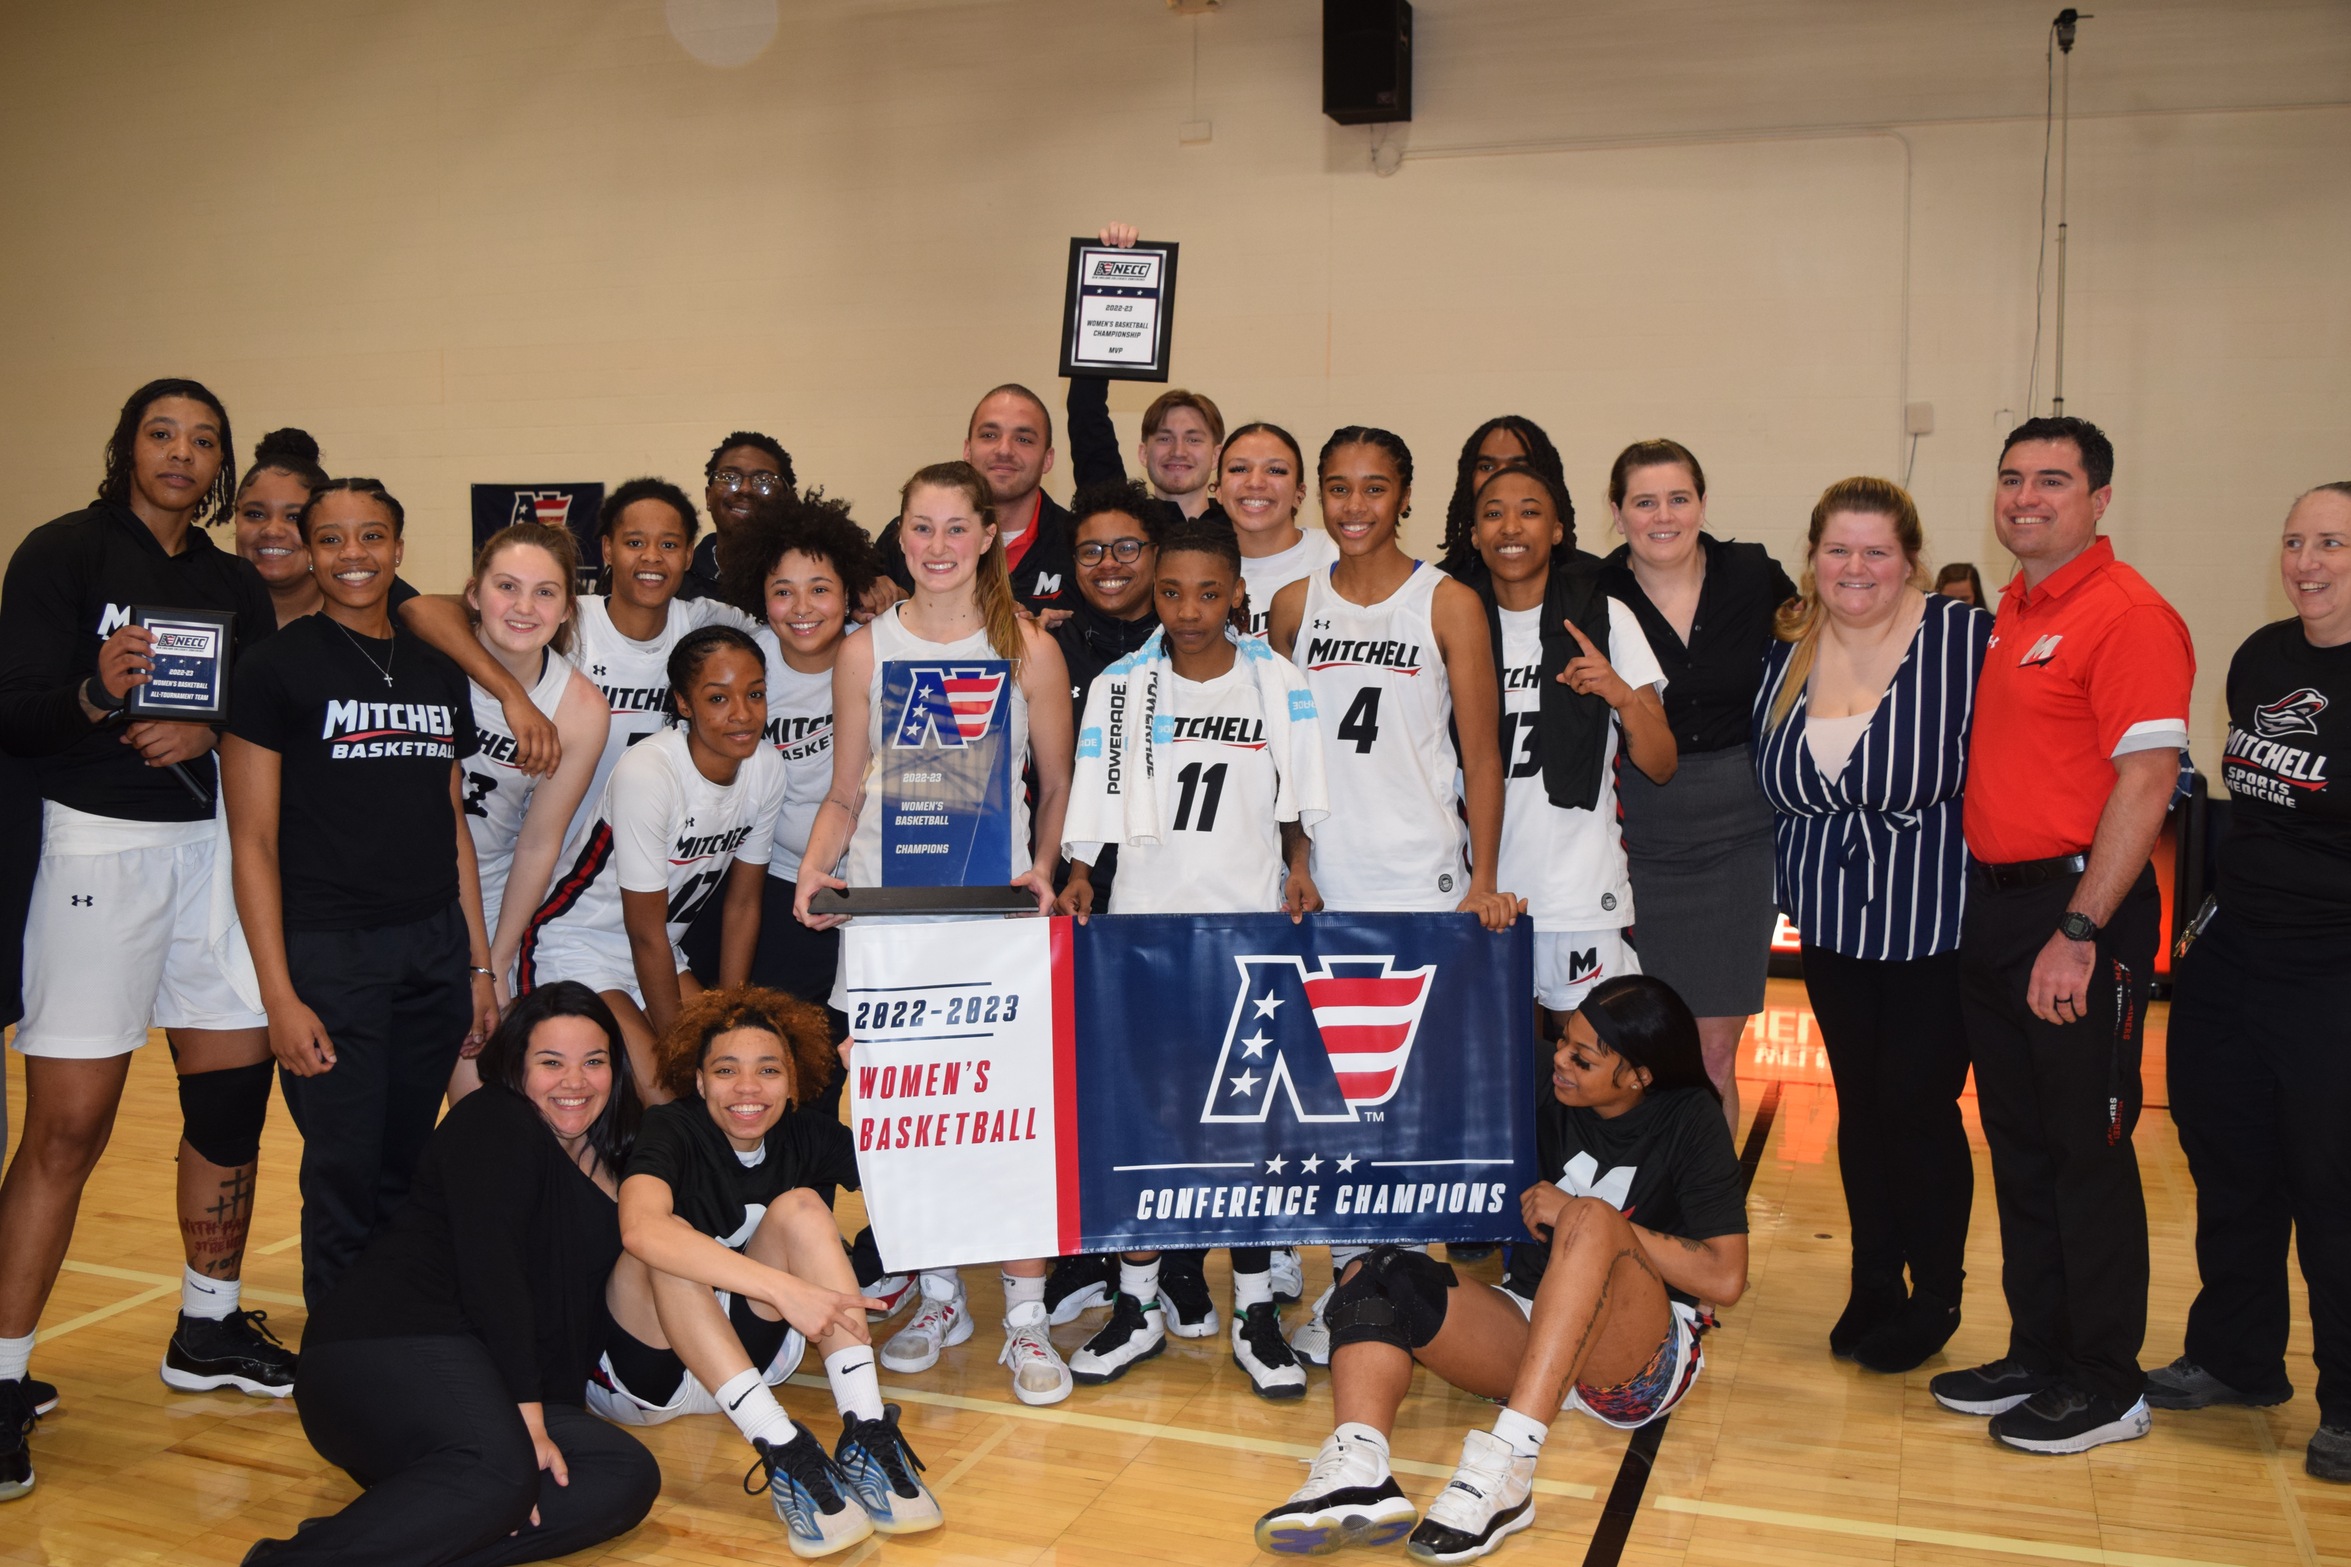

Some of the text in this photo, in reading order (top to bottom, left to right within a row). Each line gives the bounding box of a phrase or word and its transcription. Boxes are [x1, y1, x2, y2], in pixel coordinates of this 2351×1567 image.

[1113, 264, 1147, 276] NECC
[1105, 304, 1133, 312] 2022-23
[1086, 320, 1149, 330] WOMEN'S BASKETBALL
[1093, 330, 1142, 339] CHAMPIONSHIP
[175, 637, 206, 647] NECC
[1307, 637, 1421, 668] MITCHELL
[150, 690, 209, 701] ALL-TOURNAMENT TEAM
[178, 680, 208, 690] BASKETBALL
[1337, 686, 1382, 754] 4
[1107, 683, 1127, 794] POWERADE
[2227, 725, 2327, 781] MITCHELL
[902, 772, 942, 783] 2022-23
[2228, 766, 2290, 796] SPORTS
[1172, 761, 1229, 832] 11
[2225, 777, 2296, 809] MEDICINE
[900, 801, 944, 811] WOMEN'S
[895, 815, 949, 826] BASKETBALL
[895, 844, 949, 854] CHAMPIONS
[854, 994, 1019, 1029] 2022-2023
[859, 1059, 991, 1099] WOMEN'S
[859, 1107, 1036, 1152] BASKETBALL
[1136, 1182, 1507, 1220] CONFERENCE CHAMPIONS
